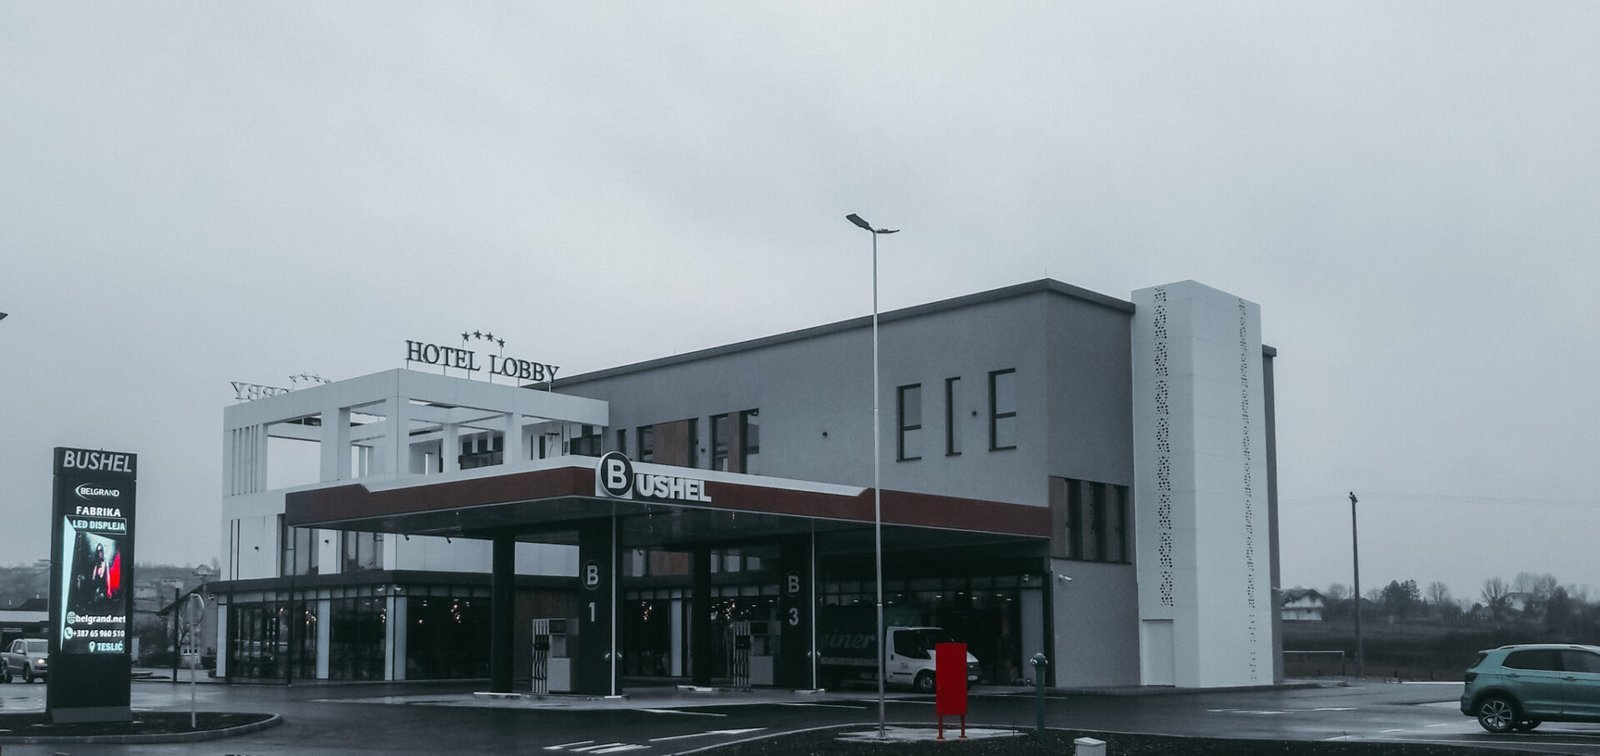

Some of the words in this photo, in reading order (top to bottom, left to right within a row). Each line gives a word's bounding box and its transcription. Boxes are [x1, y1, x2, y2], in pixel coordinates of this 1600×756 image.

[405, 340, 481, 372] HOTEL
[488, 354, 560, 383] LOBBY
[63, 450, 132, 472] BUSHEL
[80, 487, 120, 497] BELGRAND
[76, 506, 121, 517] FABRIKA
[73, 520, 88, 529] LED
[89, 521, 125, 531] DISPLEJA
[587, 564, 599, 585] B
[788, 575, 800, 593] B
[588, 602, 596, 622] 1
[788, 608, 800, 626] 3
[75, 614, 126, 625] belgrand.net
[90, 629, 98, 637] 65
[113, 629, 125, 637] 510
[97, 640, 123, 651] TESLIĆ
